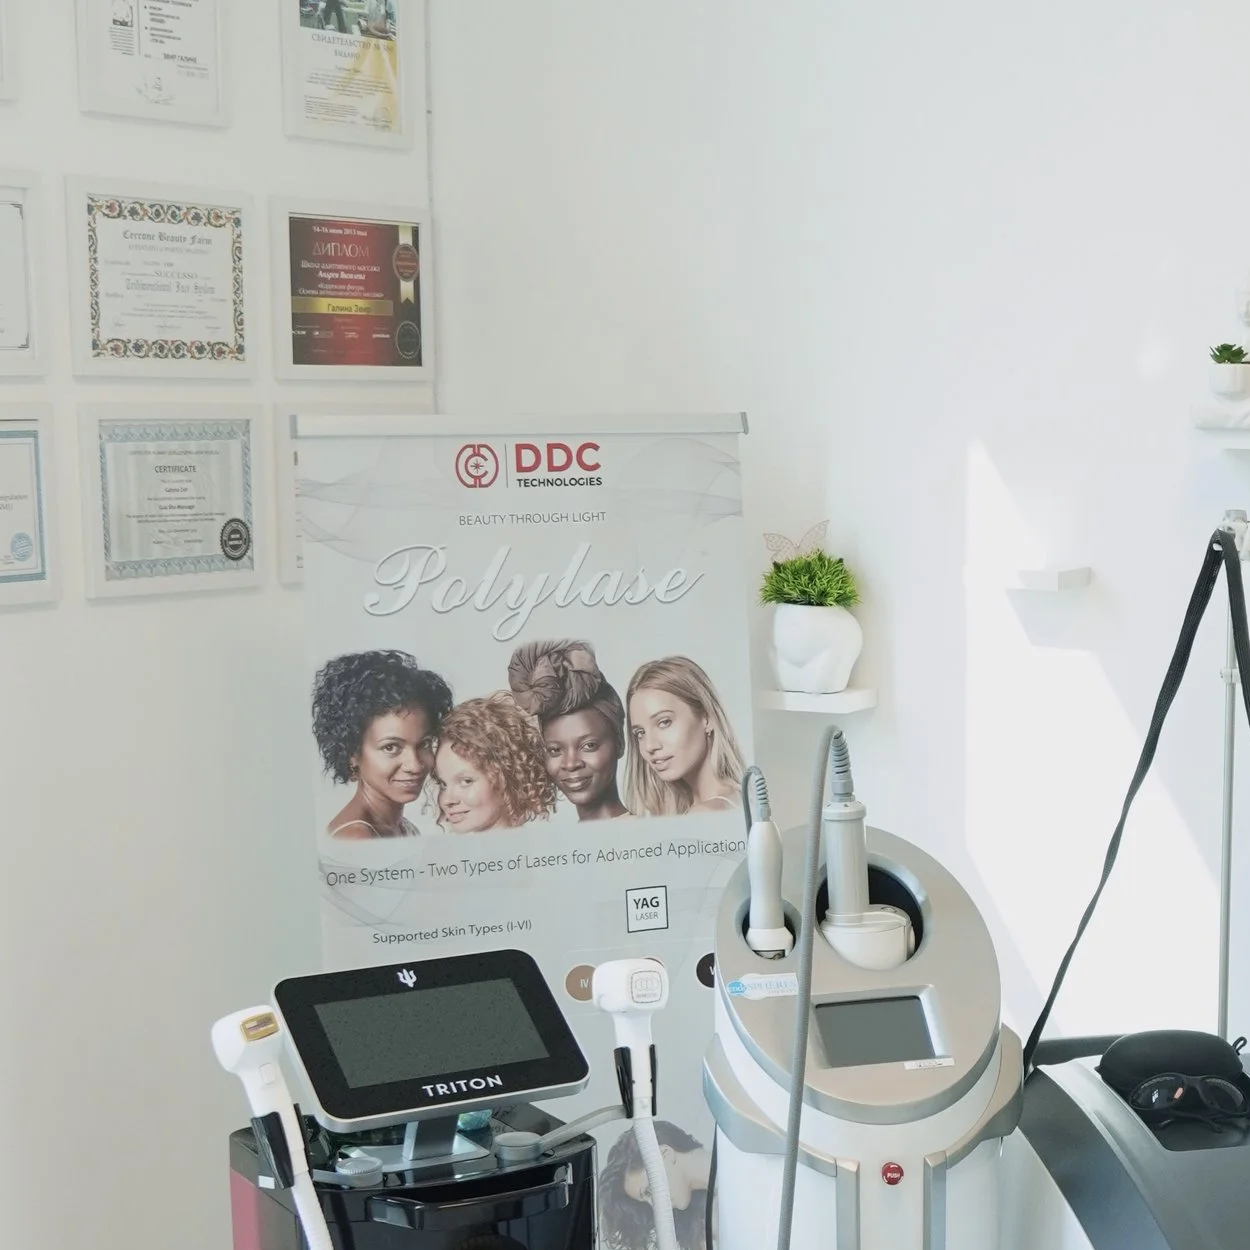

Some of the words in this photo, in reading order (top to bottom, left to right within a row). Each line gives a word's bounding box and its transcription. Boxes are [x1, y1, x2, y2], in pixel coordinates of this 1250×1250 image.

[122, 229, 156, 241] Cerrone
[158, 232, 187, 243] Beauty
[189, 234, 212, 246] Farm
[312, 241, 370, 258] ДИПЛОМ
[327, 303, 353, 313] Галина
[515, 442, 602, 473] DDC
[154, 465, 197, 473] CERTIFICATE
[516, 477, 603, 488] TECHNOLOGIES
[459, 514, 506, 526] BEAUTY
[508, 512, 569, 525] THROUGH
[572, 511, 607, 523] LIGHT
[363, 542, 705, 642] Polylase
[326, 871, 357, 887] One
[360, 866, 415, 886] System
[427, 863, 458, 877] Two
[460, 858, 504, 876] Types
[507, 854, 524, 870] of
[526, 852, 568, 869] Lasers
[572, 850, 592, 865] for
[596, 843, 662, 863] Advanced
[633, 896, 660, 910] YAG
[635, 911, 659, 921] LASER
[373, 929, 439, 944] Supported
[441, 926, 466, 938] Skin
[468, 923, 504, 938] Types
[506, 919, 532, 932] (I-VI)
[580, 978, 589, 988] IV
[421, 1074, 503, 1097] TRITON
